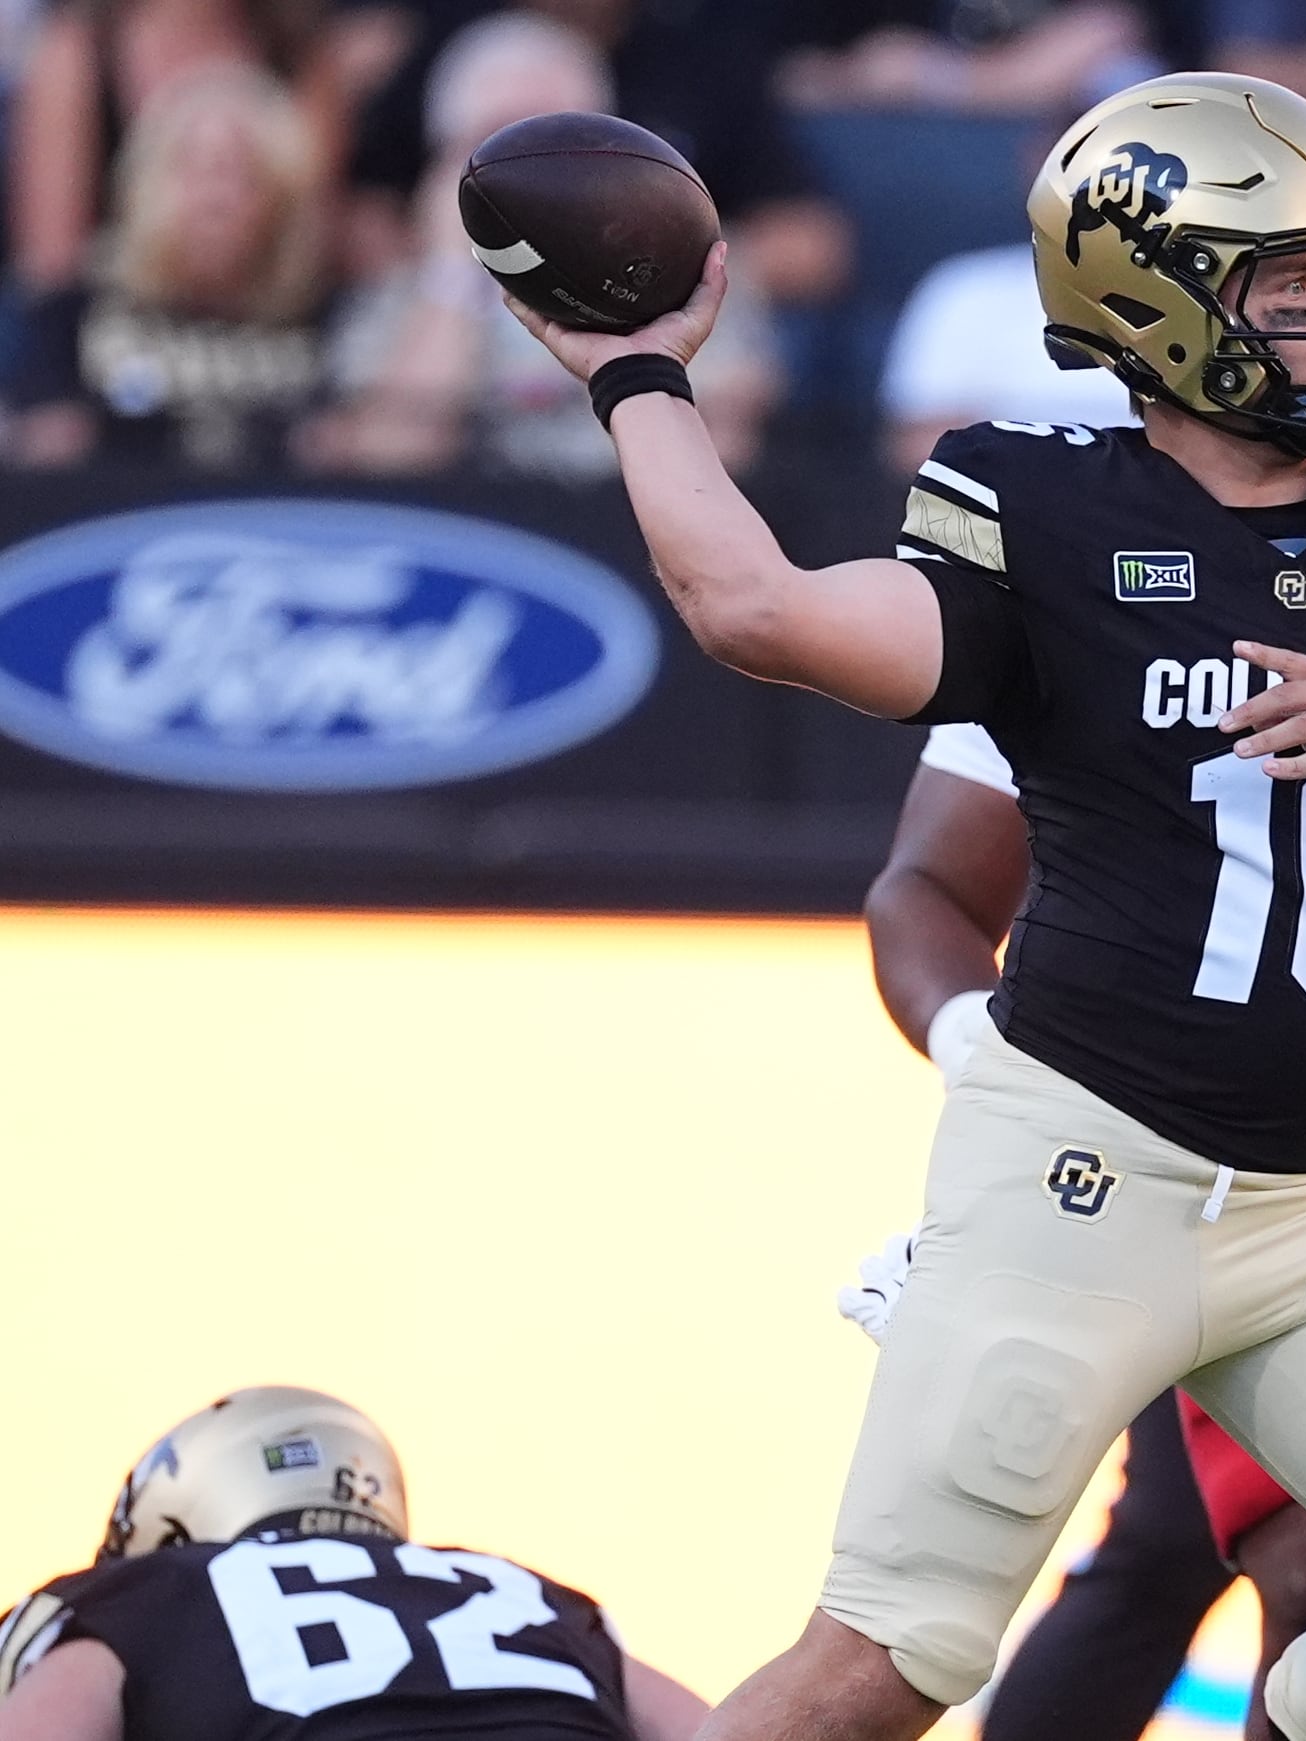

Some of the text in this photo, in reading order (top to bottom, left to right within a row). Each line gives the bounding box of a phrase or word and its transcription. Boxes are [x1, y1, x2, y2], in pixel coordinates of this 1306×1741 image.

[64, 532, 518, 748] Ford
[1045, 1146, 1119, 1219] CU
[206, 1537, 599, 1719] 62
